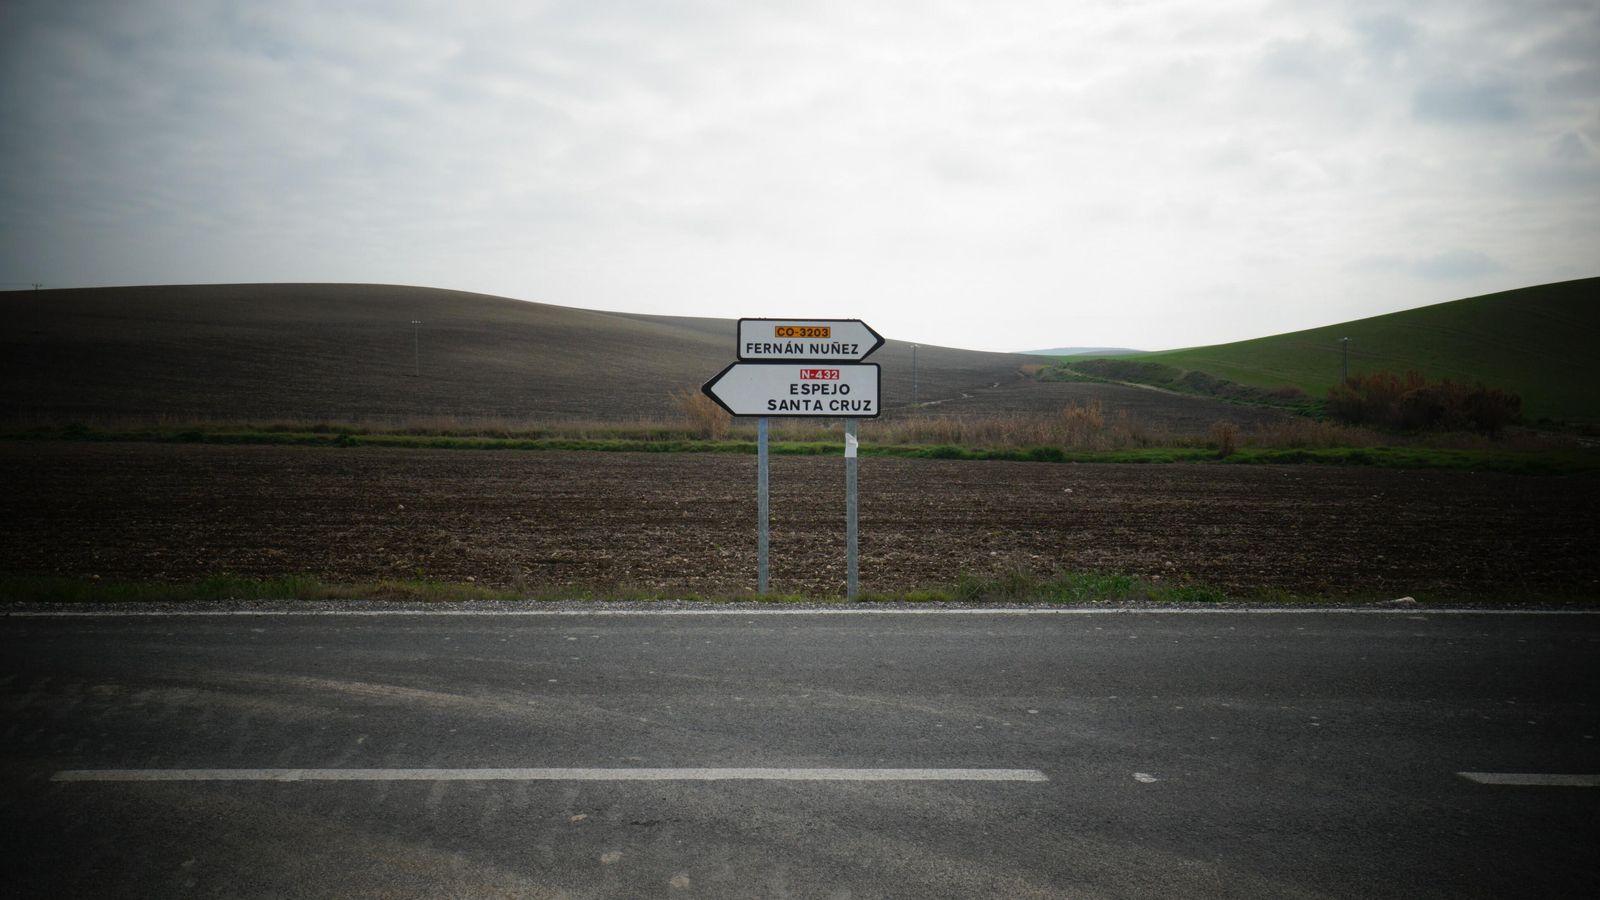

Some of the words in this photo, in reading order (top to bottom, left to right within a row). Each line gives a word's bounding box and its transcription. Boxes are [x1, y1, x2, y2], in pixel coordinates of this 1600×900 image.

[776, 327, 829, 337] CO-3203
[746, 341, 804, 354] FERNÁN
[809, 341, 859, 354] NUÑEZ
[801, 370, 838, 379] N-432
[790, 383, 850, 395] ESPEJO
[767, 399, 823, 411] SANTA
[829, 399, 871, 411] CRUZ
